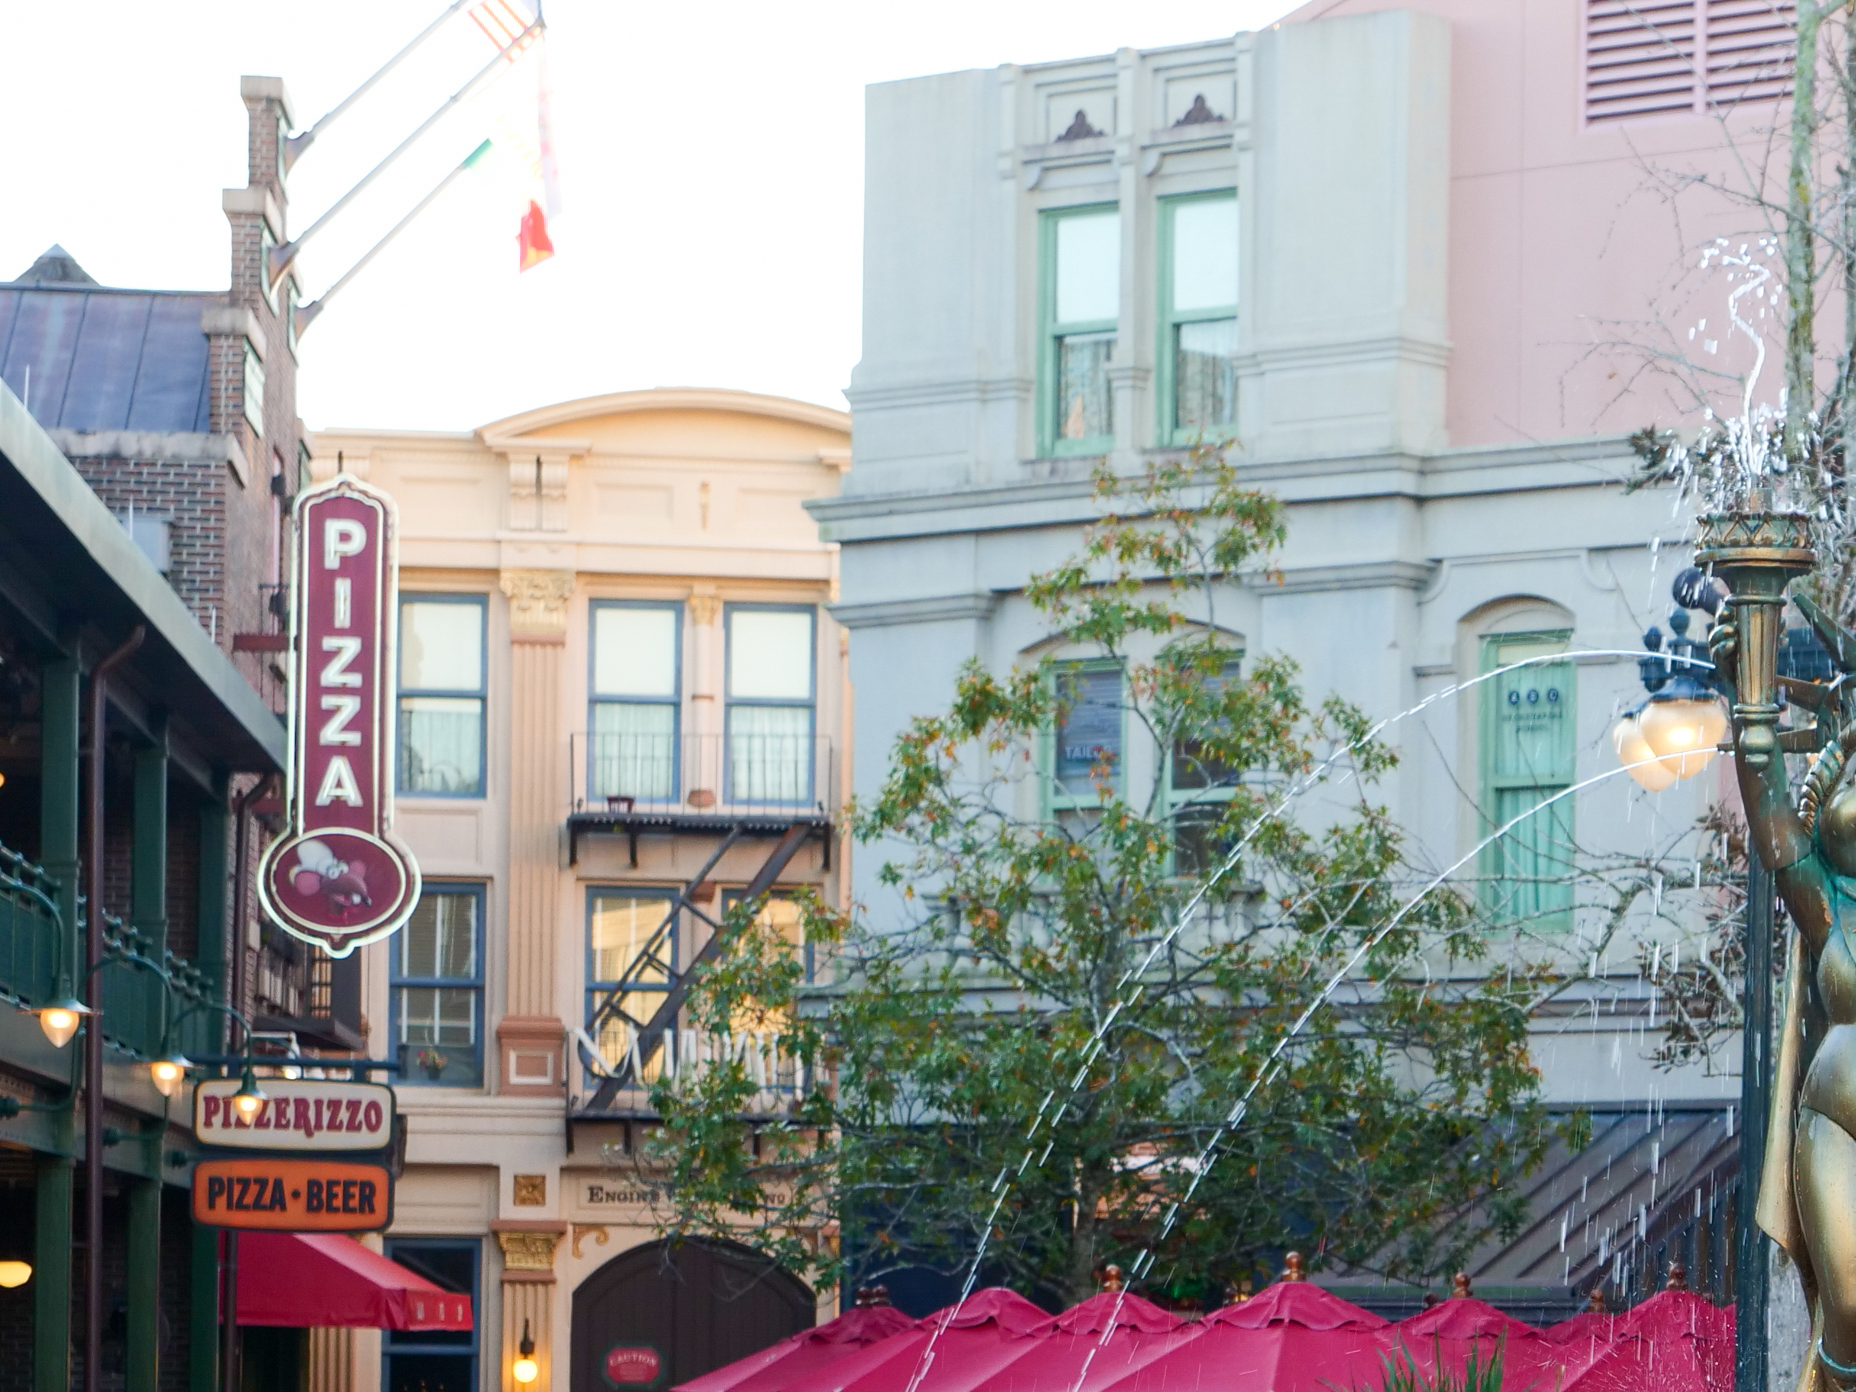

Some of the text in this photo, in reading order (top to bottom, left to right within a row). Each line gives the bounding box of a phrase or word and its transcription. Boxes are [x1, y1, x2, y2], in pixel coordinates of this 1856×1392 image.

[315, 518, 368, 807] PIZZA
[208, 1175, 376, 1214] PIZZA BEER
